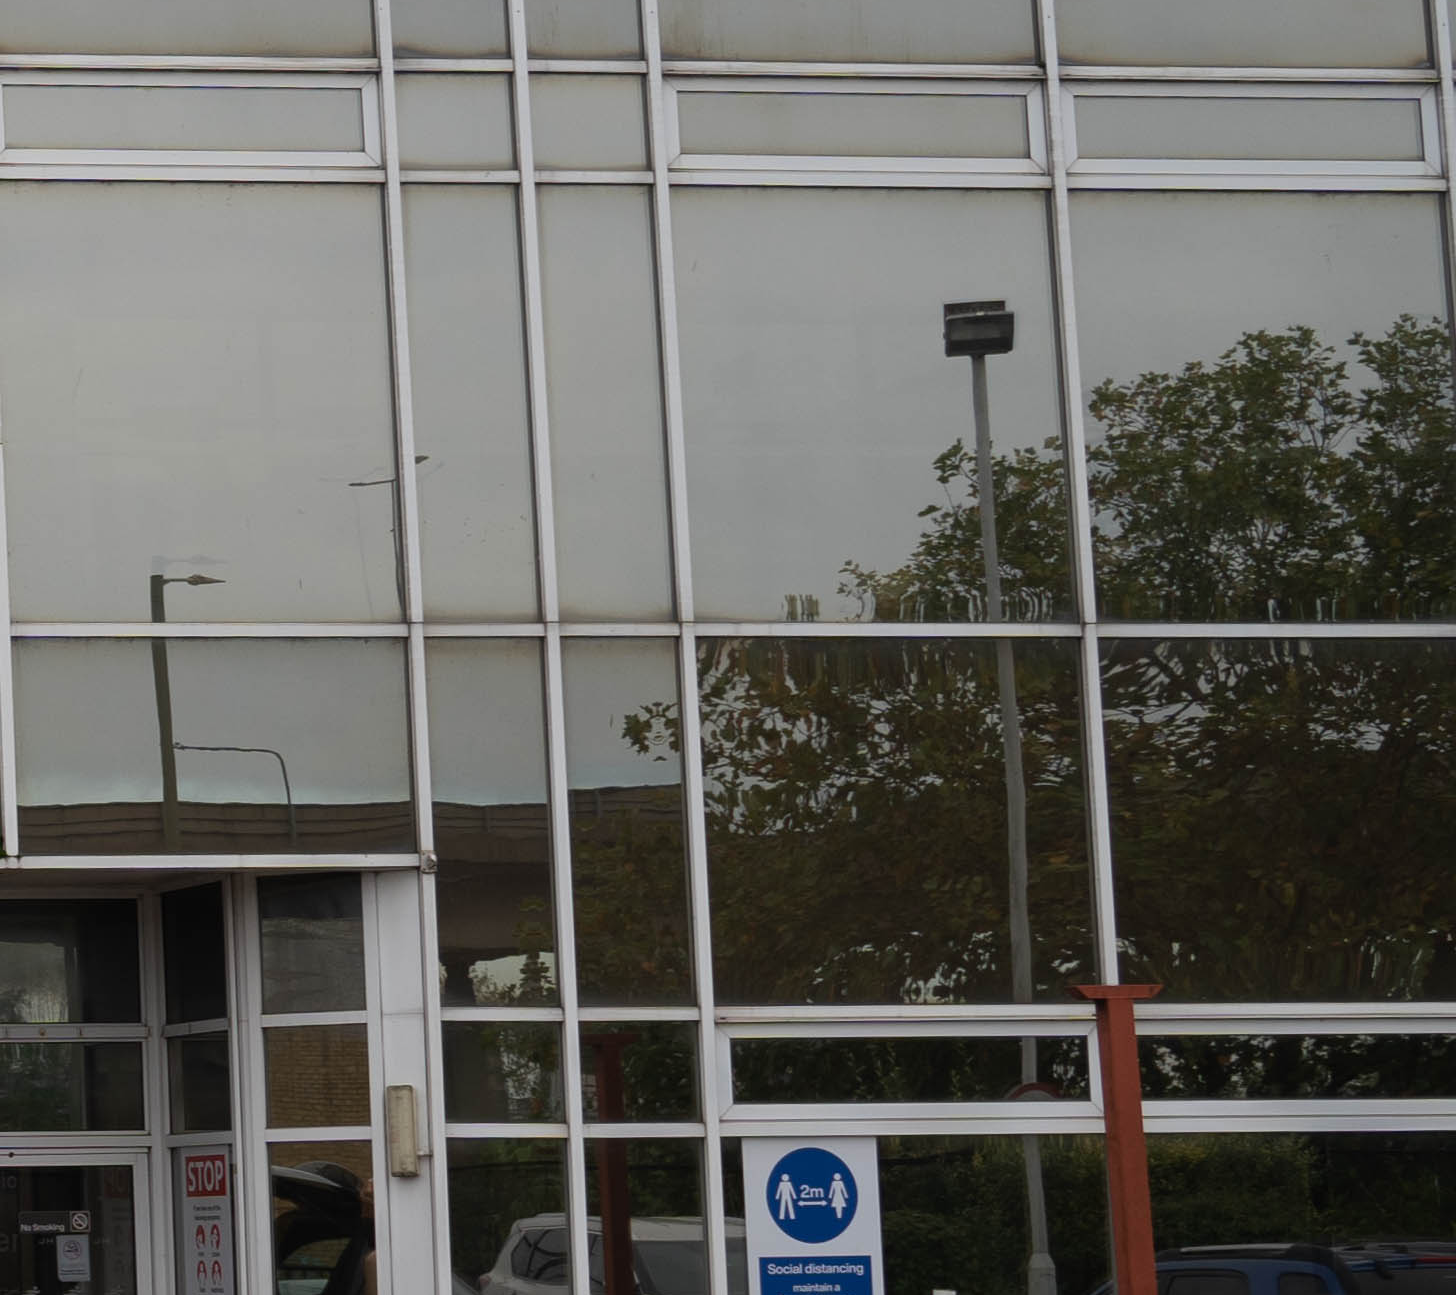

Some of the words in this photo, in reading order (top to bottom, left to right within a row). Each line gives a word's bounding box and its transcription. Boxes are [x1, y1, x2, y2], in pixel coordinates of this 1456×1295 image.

[187, 1161, 224, 1192] STOP
[800, 1184, 824, 1198] 2m
[767, 1263, 803, 1275] Social
[804, 1263, 864, 1276] distancing
[792, 1282, 833, 1292] maintain
[834, 1284, 841, 1292] a
